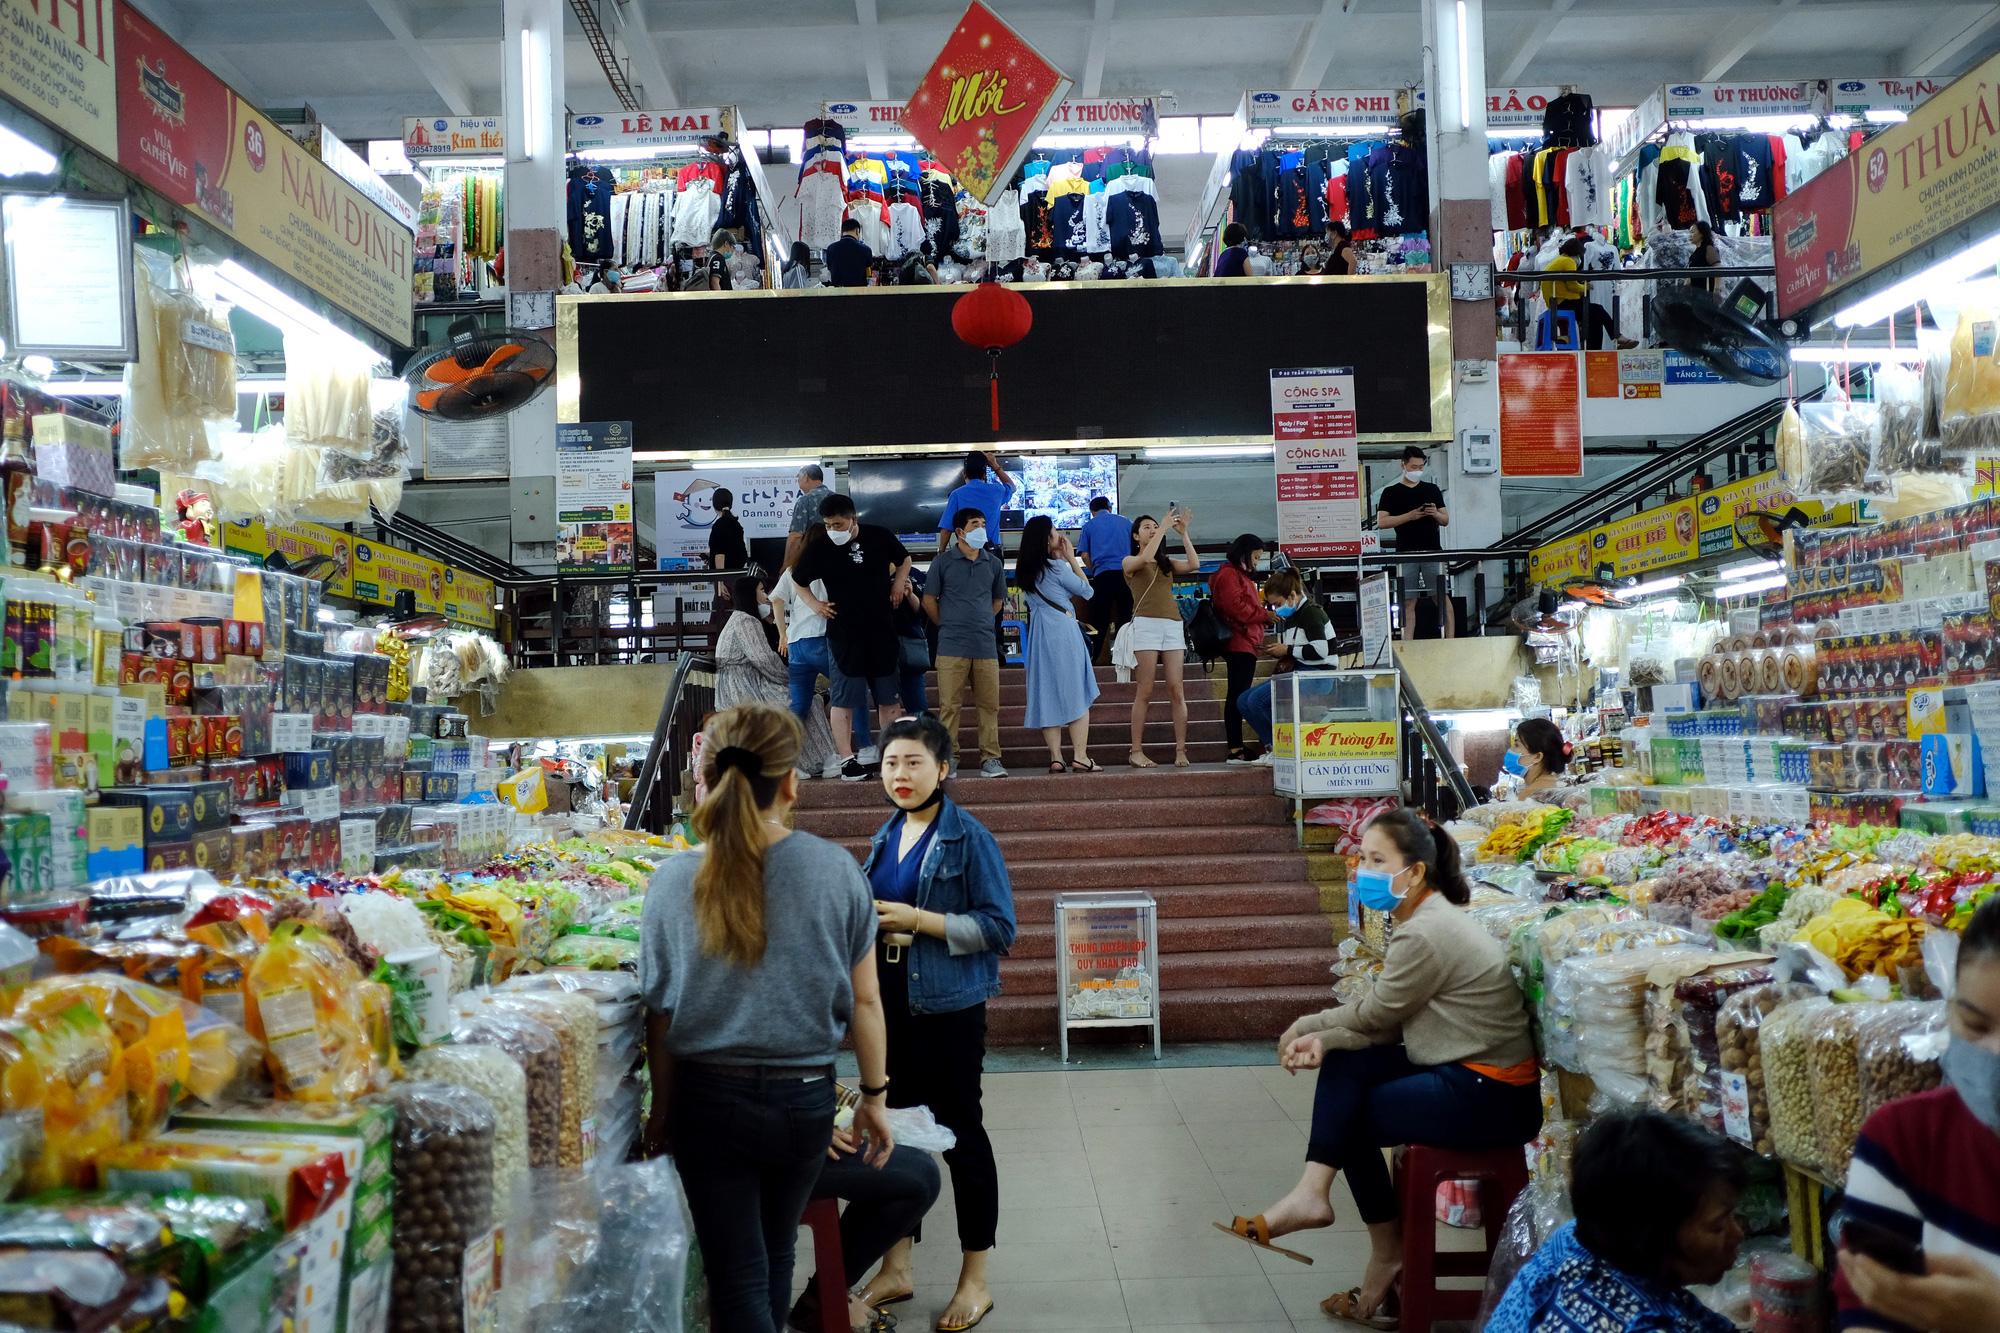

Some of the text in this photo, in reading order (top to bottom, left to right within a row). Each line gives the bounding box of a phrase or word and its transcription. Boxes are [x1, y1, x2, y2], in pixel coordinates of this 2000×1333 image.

[939, 70, 1026, 131] Mới
[1486, 89, 1547, 111] HẢO
[1714, 85, 1800, 102] ÚT THƯƠNG
[1076, 100, 1143, 121] THƯƠNG
[1355, 97, 1390, 111] NHI
[460, 117, 496, 130] hiệu vải
[621, 113, 710, 134] LÊ MAI
[247, 125, 262, 158] 36
[451, 132, 476, 151] Kim
[1894, 82, 2000, 191] THUẬ
[1870, 152, 1884, 181] 52
[281, 145, 339, 235] NAM
[344, 195, 406, 282] ĐỊNH
[1321, 387, 1341, 396] SPA
[1323, 447, 1347, 458] NAIL
[1722, 478, 1778, 504] GIA VỊ THỰC
[1706, 498, 1715, 506] LÔ
[742, 509, 783, 519] Danang
[1818, 512, 1834, 525] LOẠI
[1609, 528, 1620, 538] GIA
[1650, 510, 1673, 525] PHẨM
[1616, 524, 1667, 554] CHỊ BÊ
[373, 550, 386, 561] GIA
[1543, 560, 1555, 573] CÔ
[1329, 732, 1395, 749] Tường An
[1379, 750, 1397, 758] ngon!
[1308, 762, 1390, 776] CÂN ĐỐI CHỨNG
[1117, 980, 1139, 988] FUND
